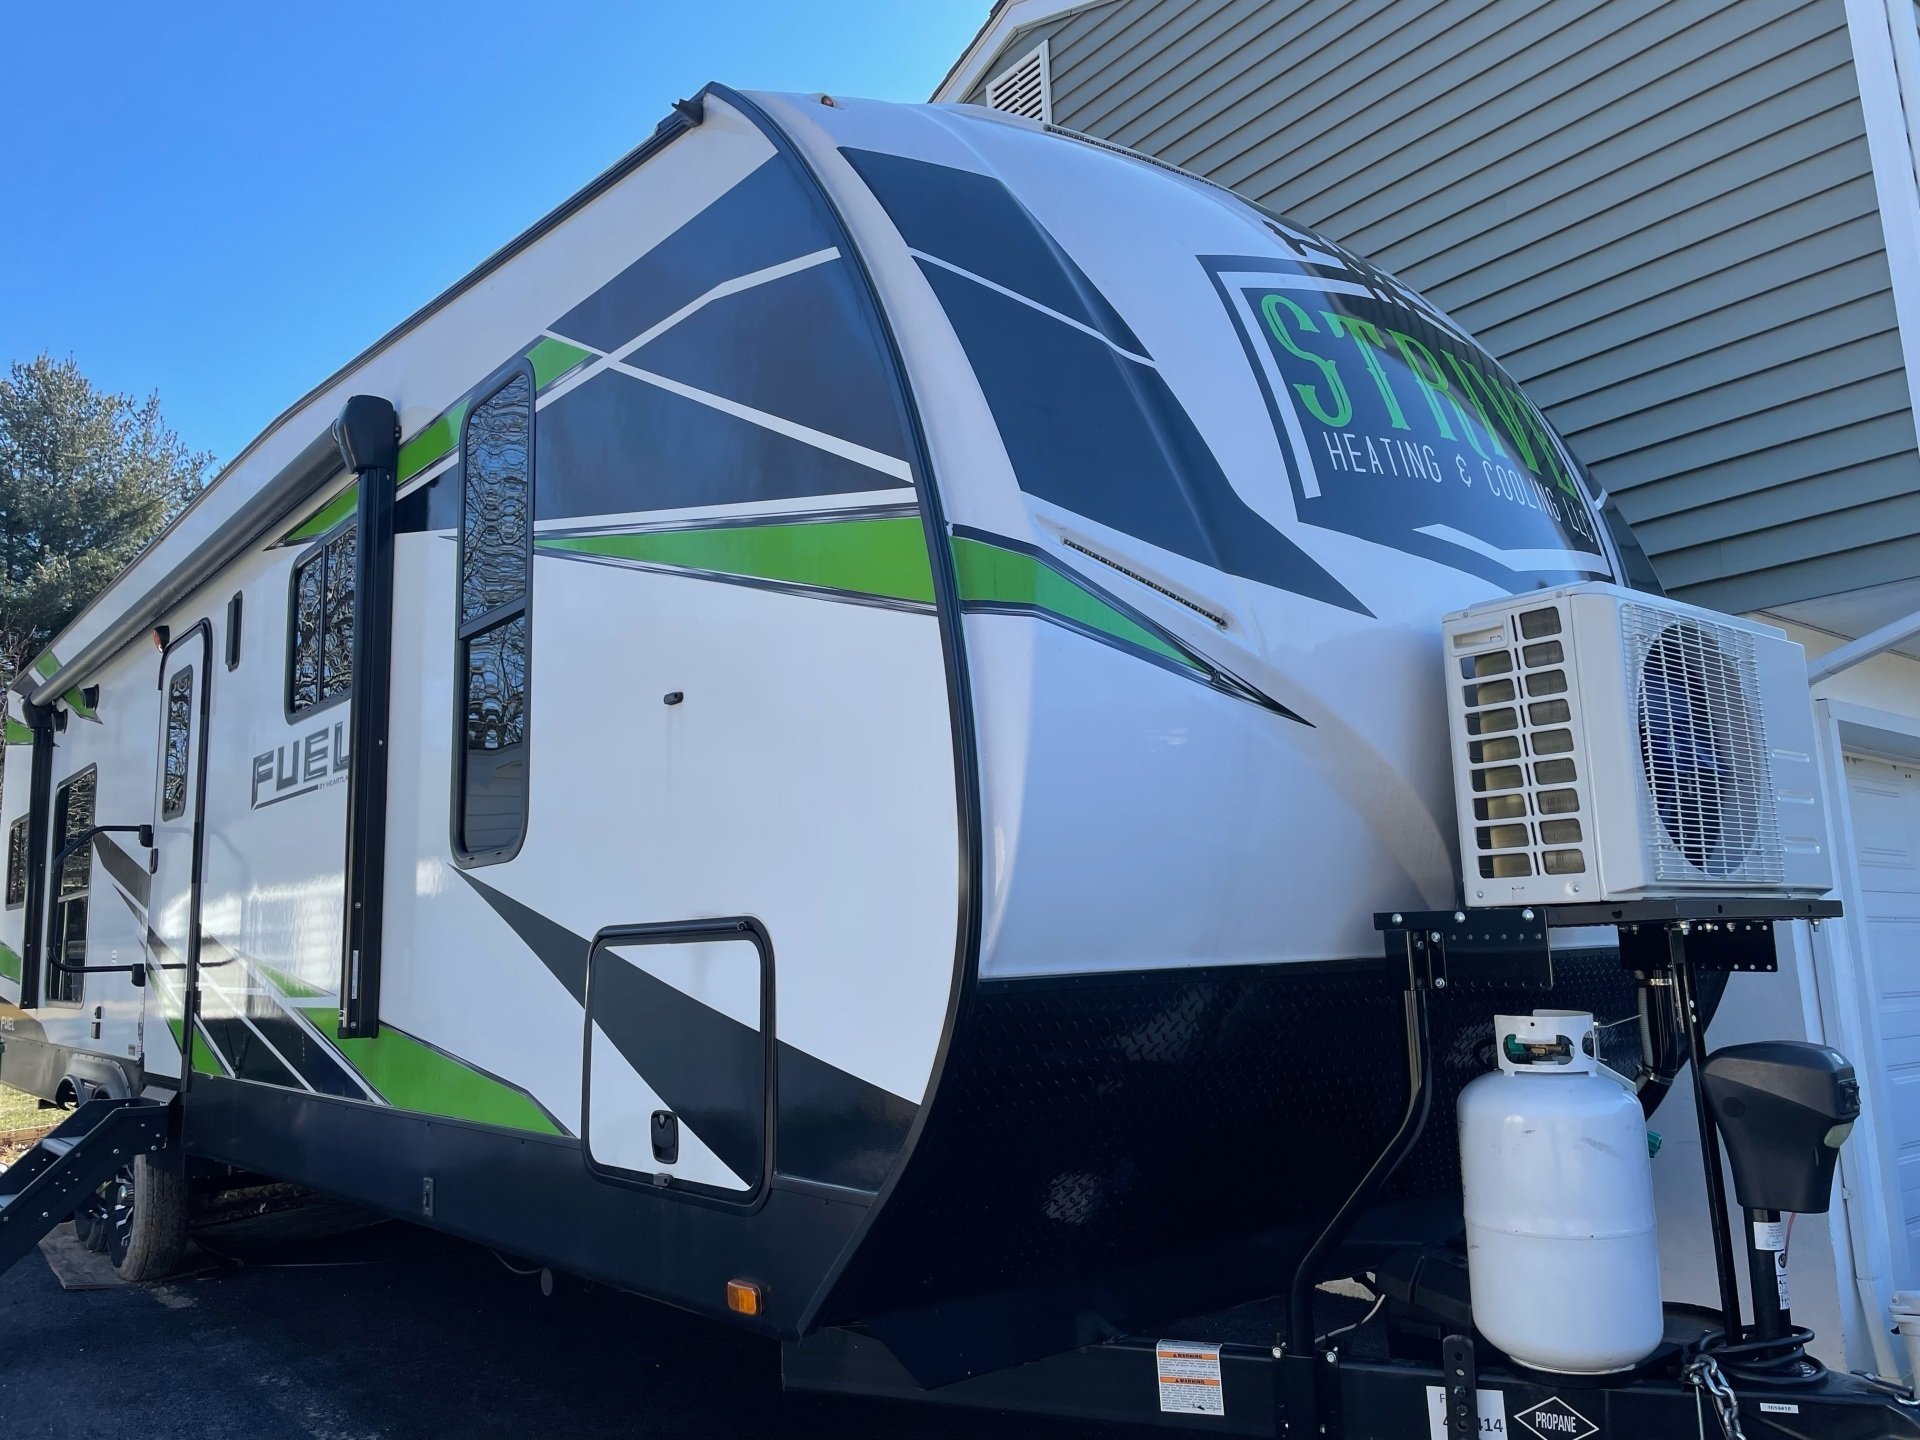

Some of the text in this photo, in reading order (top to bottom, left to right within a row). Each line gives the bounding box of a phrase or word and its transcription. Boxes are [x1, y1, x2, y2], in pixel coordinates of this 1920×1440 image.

[1260, 294, 1580, 501] STRIVE
[1323, 431, 1594, 544] HEATING & COOLING LLC
[251, 721, 349, 809] FUEL
[326, 775, 349, 787] HEARTLA
[1535, 1411, 1577, 1433] PROPANE
